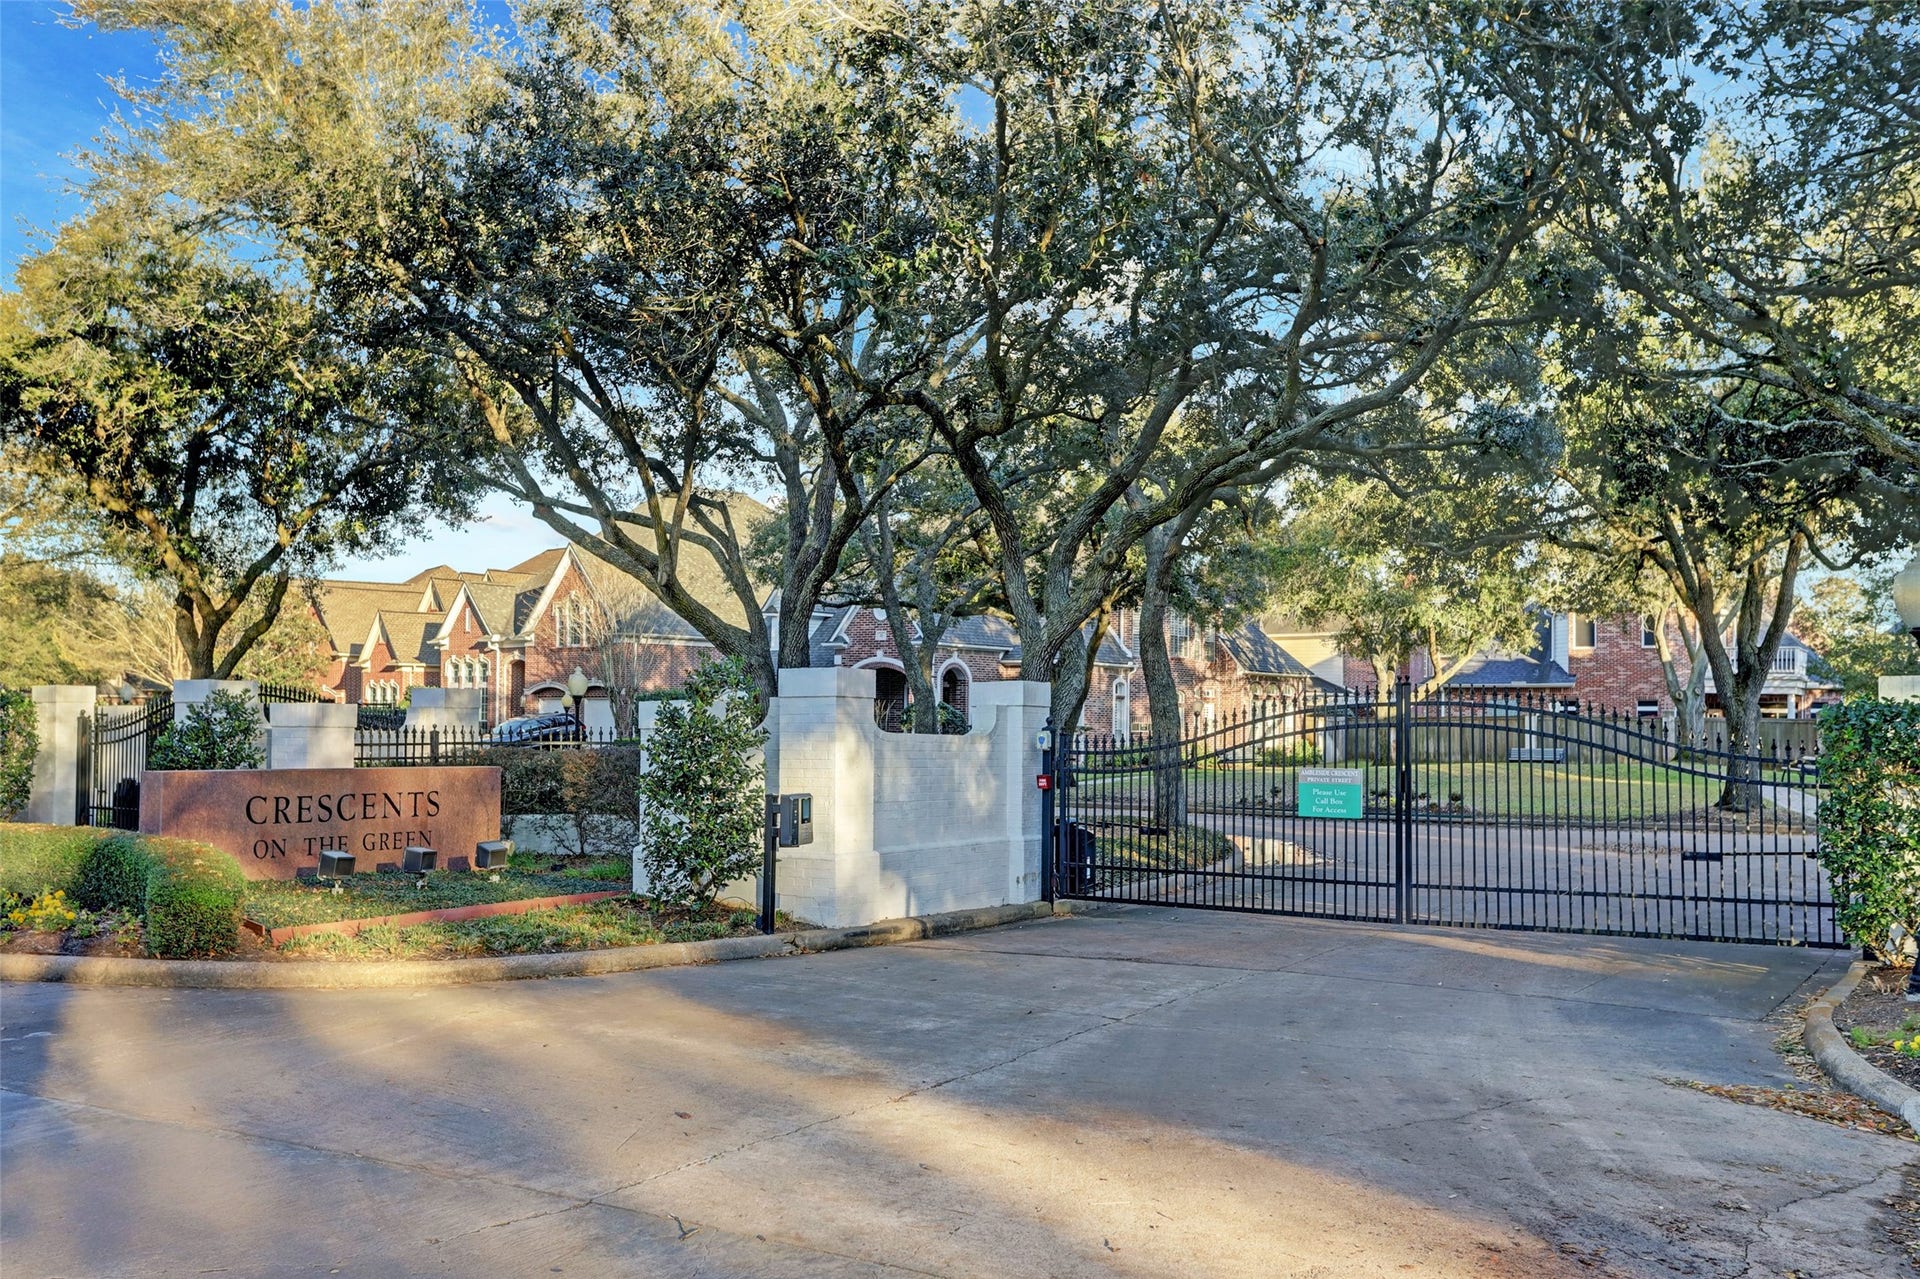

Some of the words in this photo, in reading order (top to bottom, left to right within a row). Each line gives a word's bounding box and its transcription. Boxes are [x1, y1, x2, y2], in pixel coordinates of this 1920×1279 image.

[1312, 788, 1332, 796] Please
[1334, 789, 1347, 797] Use
[1315, 797, 1328, 805] Call
[245, 790, 441, 825] CRESCENTS
[1324, 806, 1347, 814] Access
[253, 838, 287, 860] ON
[304, 835, 349, 857] THE
[362, 830, 433, 852] GREEN
